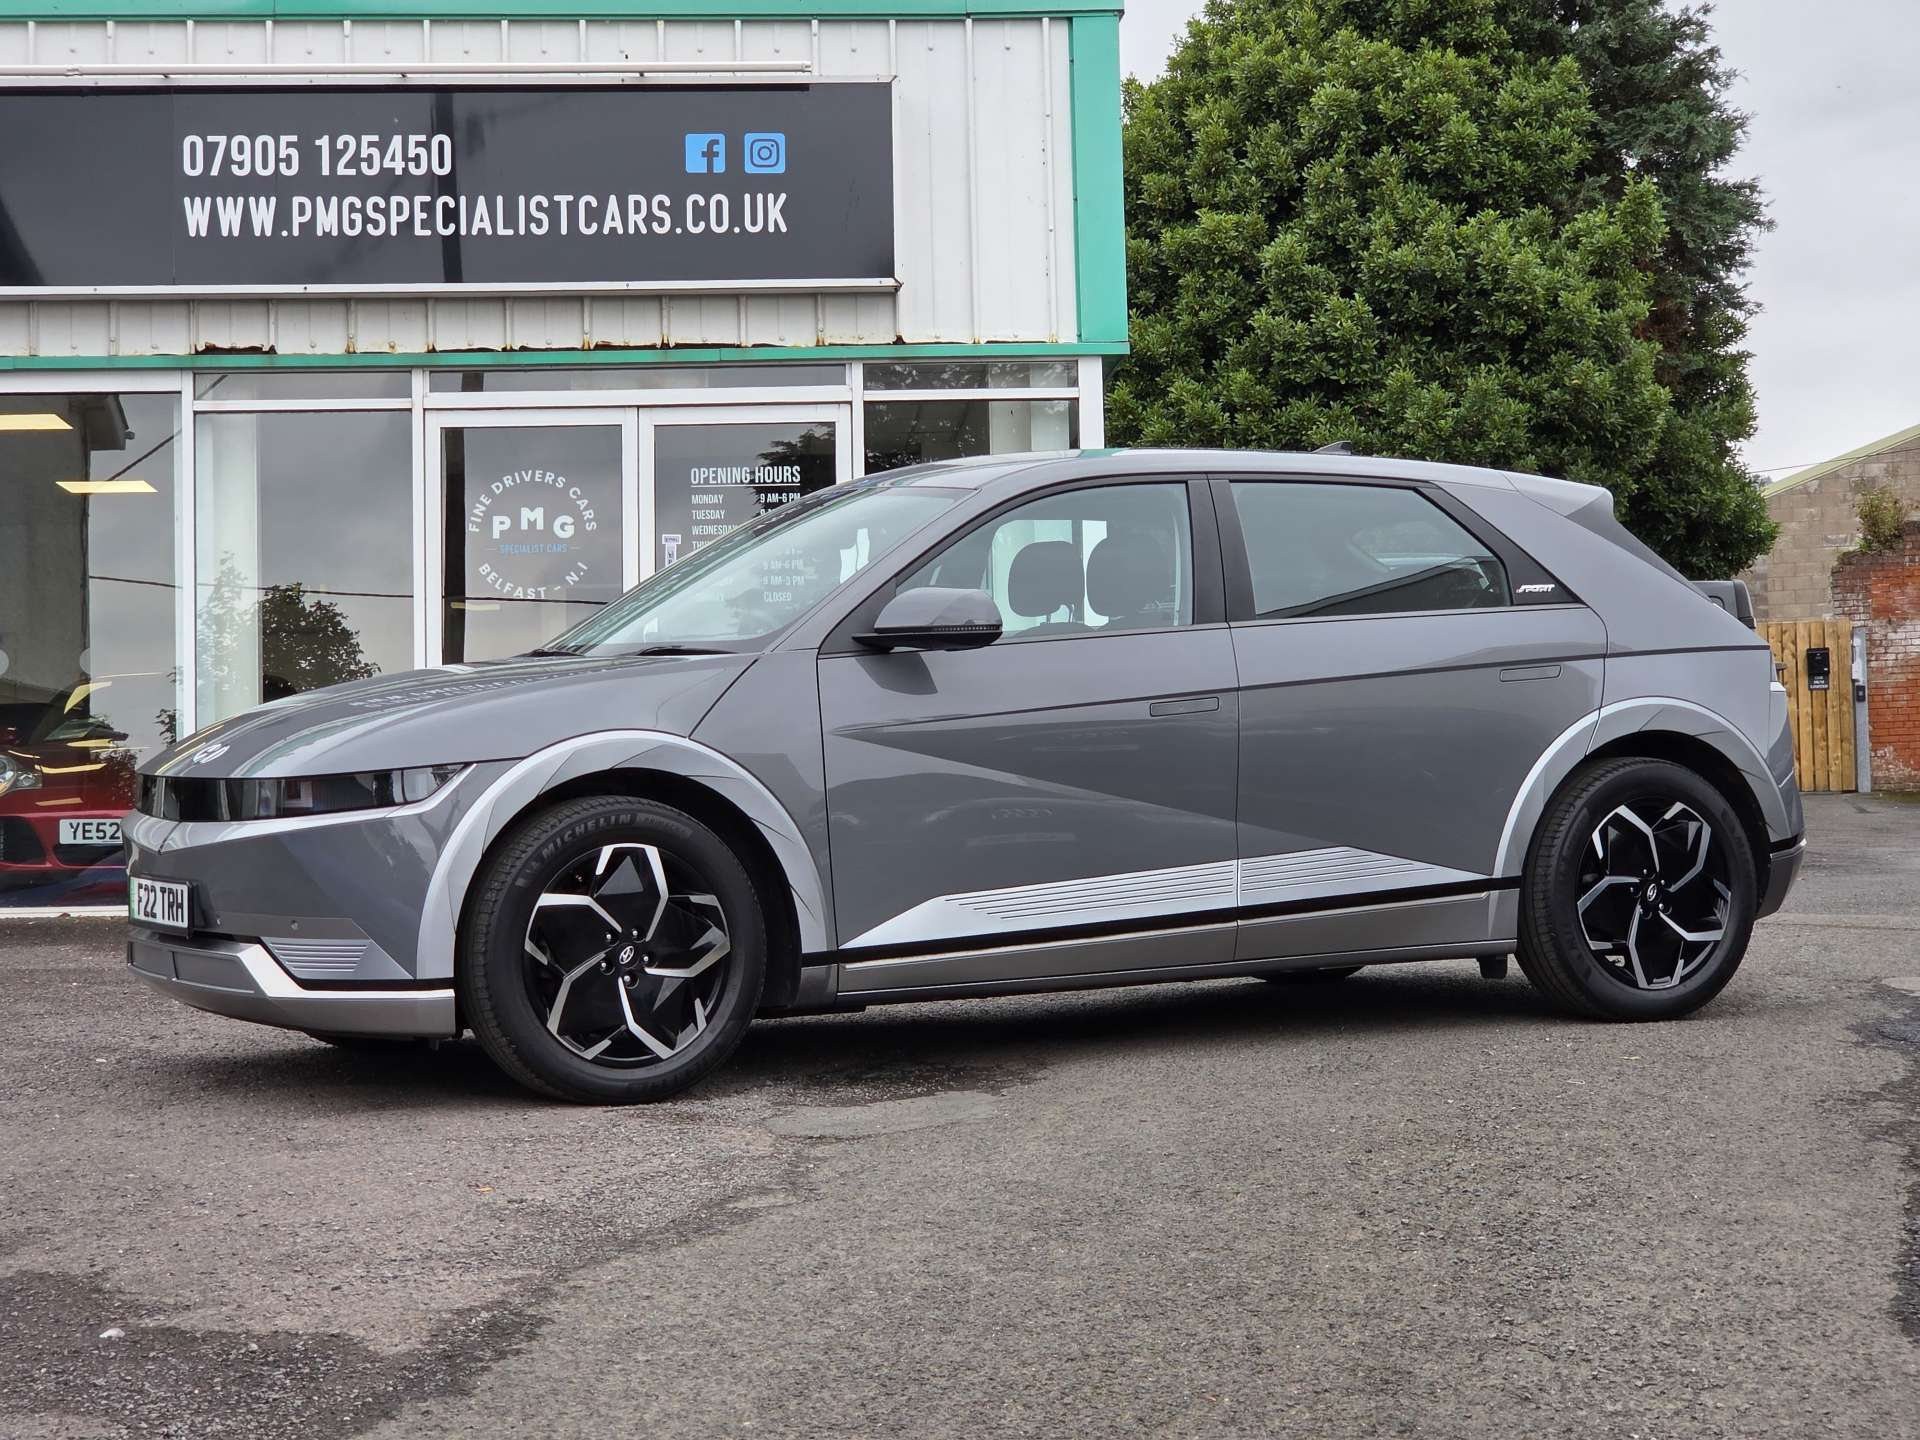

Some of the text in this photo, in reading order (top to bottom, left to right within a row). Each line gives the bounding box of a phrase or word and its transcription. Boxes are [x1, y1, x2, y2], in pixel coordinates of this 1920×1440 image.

[183, 133, 452, 176] 07905 125450
[184, 192, 788, 238] WWW.PMGSPECIALISTCARS.CO.UK
[691, 465, 801, 484] OPENING HOURS
[469, 470, 597, 532] FINE DRIVERS CARS
[691, 494, 724, 505] MONDAY
[760, 493, 766, 503] 9
[789, 492, 801, 502] PM
[692, 509, 726, 520] TUESDAY
[492, 507, 575, 539] PMG
[479, 563, 547, 599] BELFAST
[69, 821, 121, 841] YE52
[542, 814, 631, 860] MICHELIN
[138, 883, 184, 923] F22 TRH
